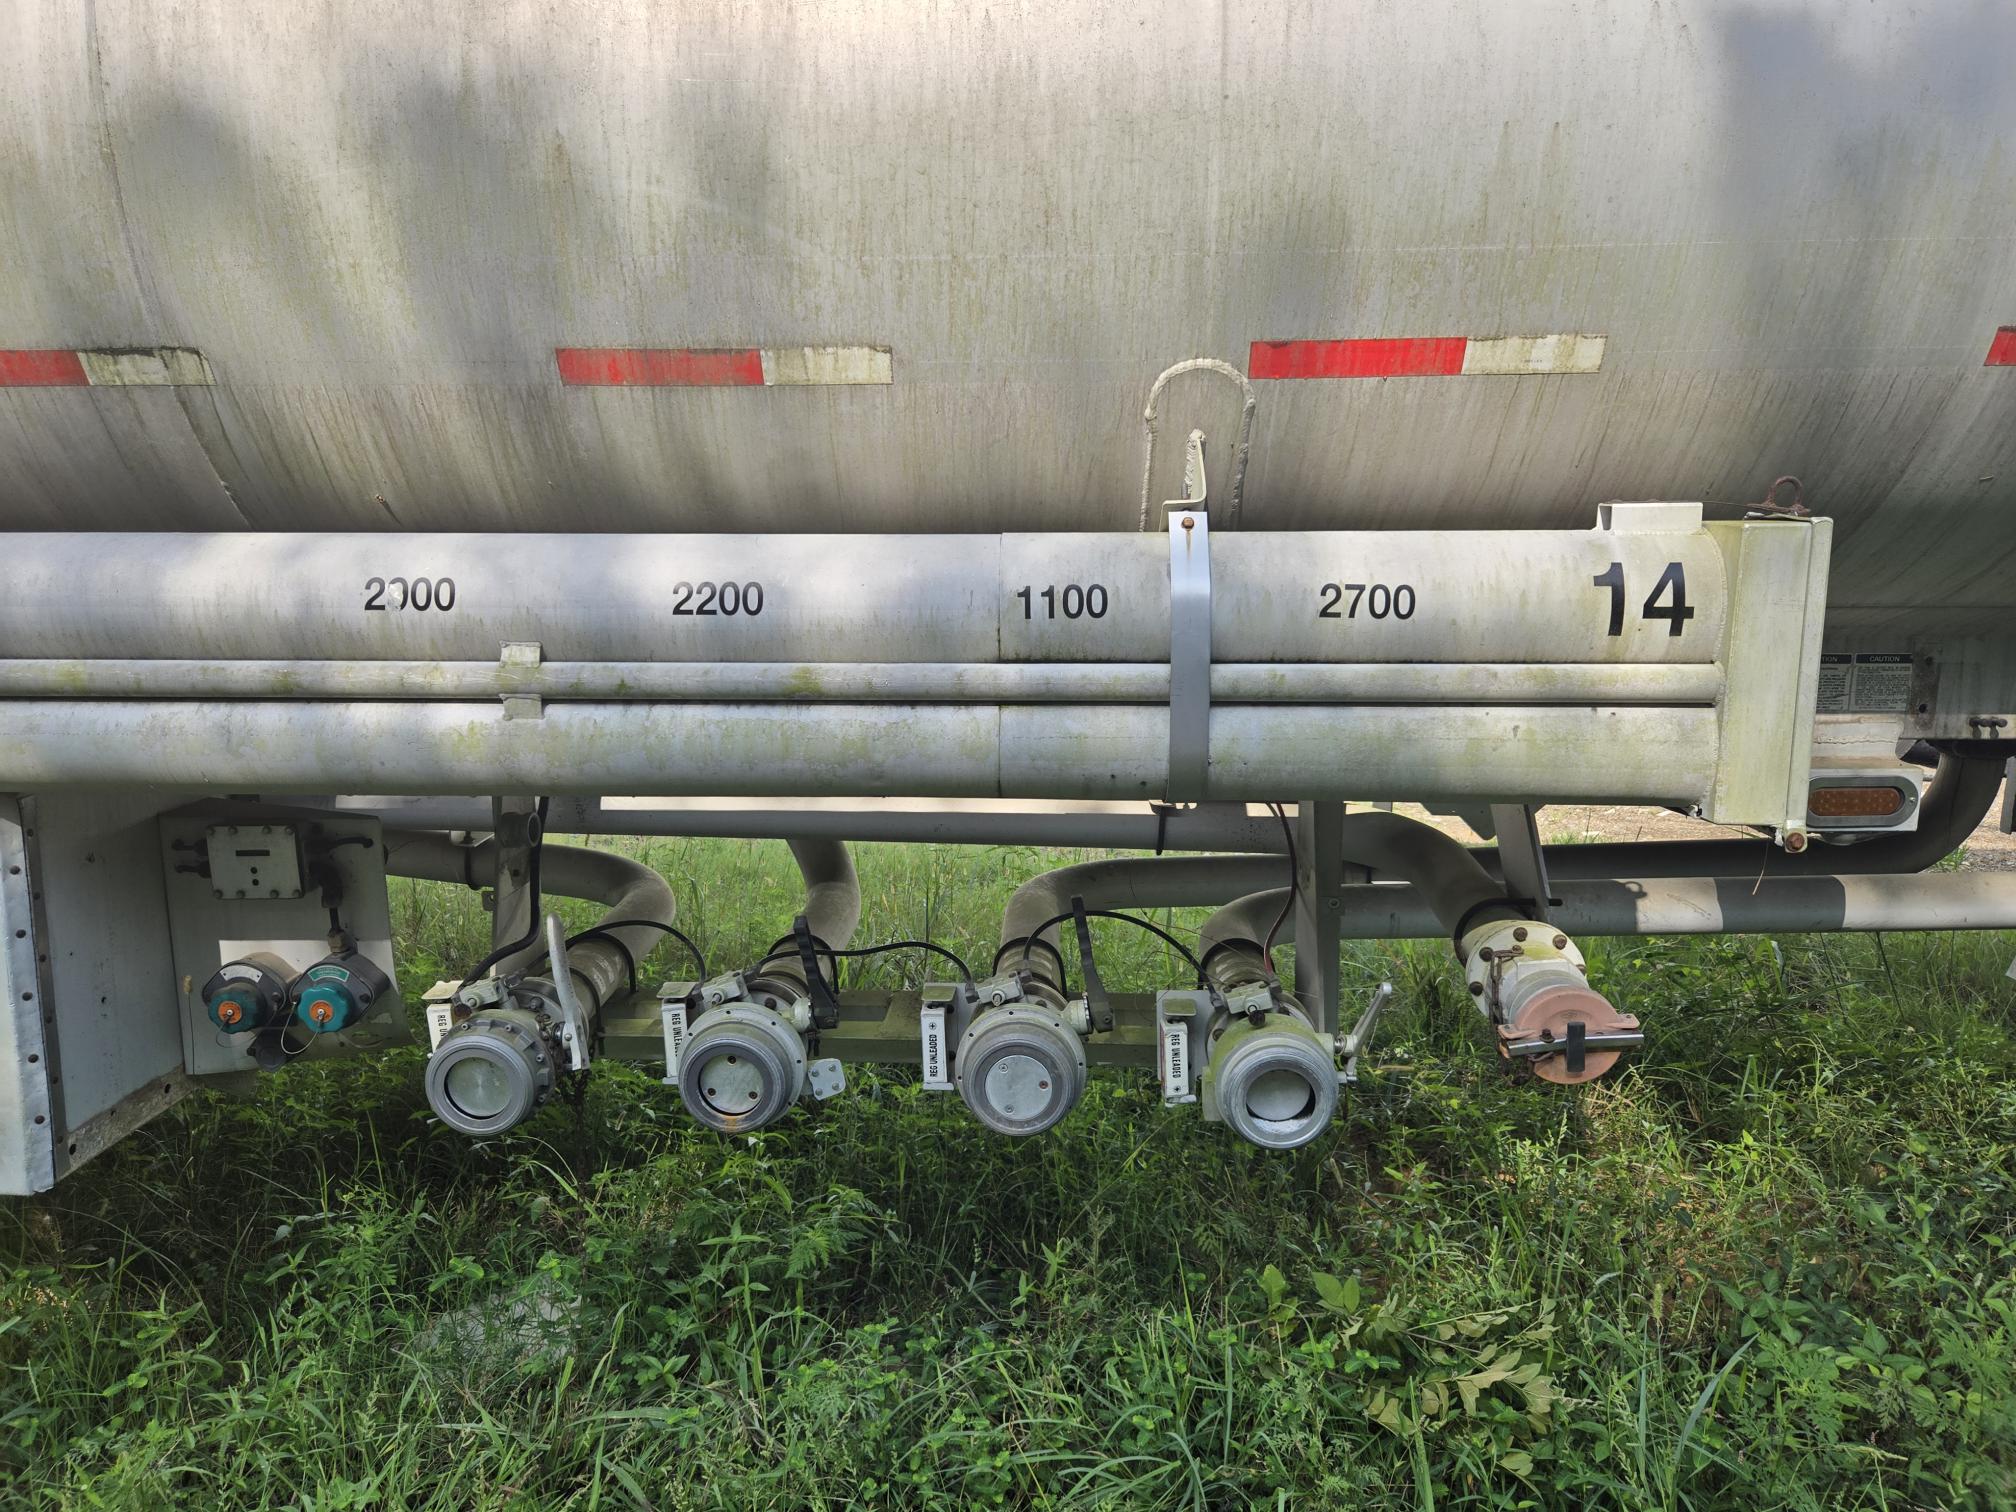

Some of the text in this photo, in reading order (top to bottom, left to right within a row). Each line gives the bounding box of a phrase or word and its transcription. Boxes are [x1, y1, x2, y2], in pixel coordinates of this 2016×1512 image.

[672, 581, 763, 615] 2200
[1016, 584, 1108, 620] 1100
[1319, 583, 1416, 620] 2700
[1593, 562, 1694, 636] 14
[1869, 655, 1900, 663] CAUTION
[437, 1014, 447, 1027] REG
[671, 1013, 681, 1026] REG
[928, 1034, 938, 1078] REG UNLEADED
[1170, 1034, 1182, 1079] REG UNLEADED
